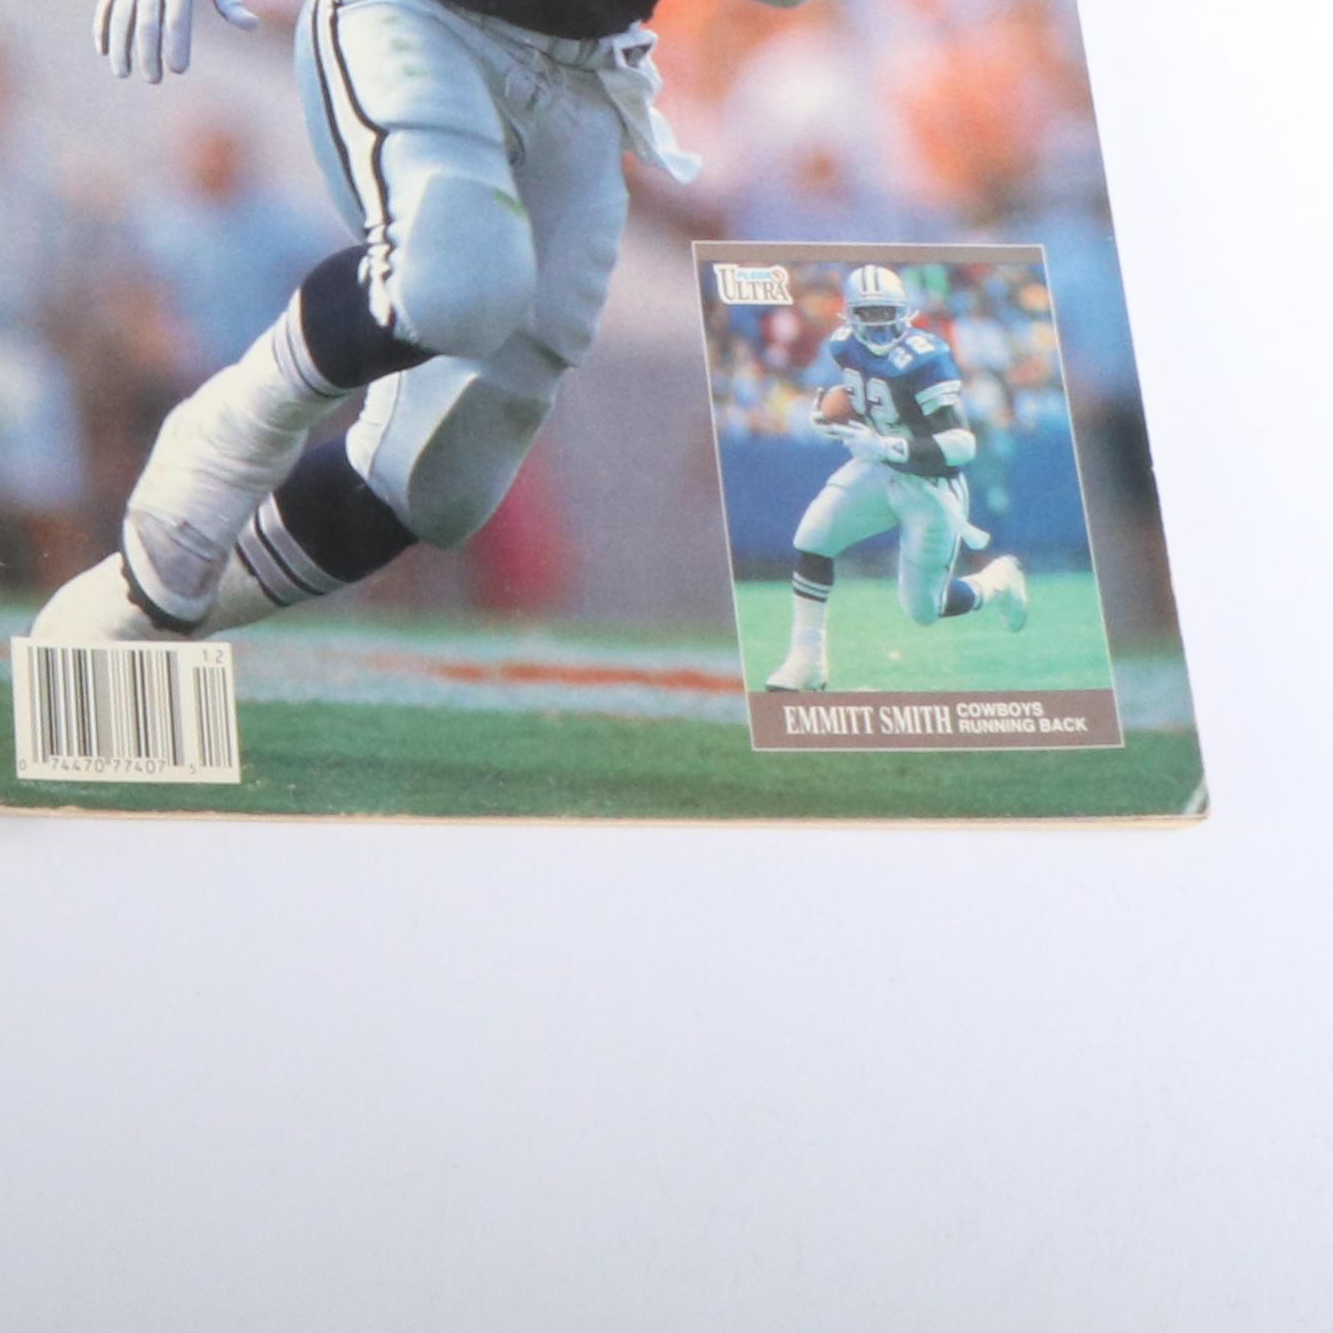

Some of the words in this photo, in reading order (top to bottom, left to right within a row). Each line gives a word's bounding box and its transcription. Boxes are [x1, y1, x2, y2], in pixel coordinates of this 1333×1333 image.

[718, 266, 790, 302] ULTRA
[783, 705, 874, 735] EMMITT
[879, 704, 953, 734] SMITH
[956, 701, 1045, 717] COWBOYS
[958, 718, 1034, 733] RUNNING
[1040, 717, 1089, 732] BACK
